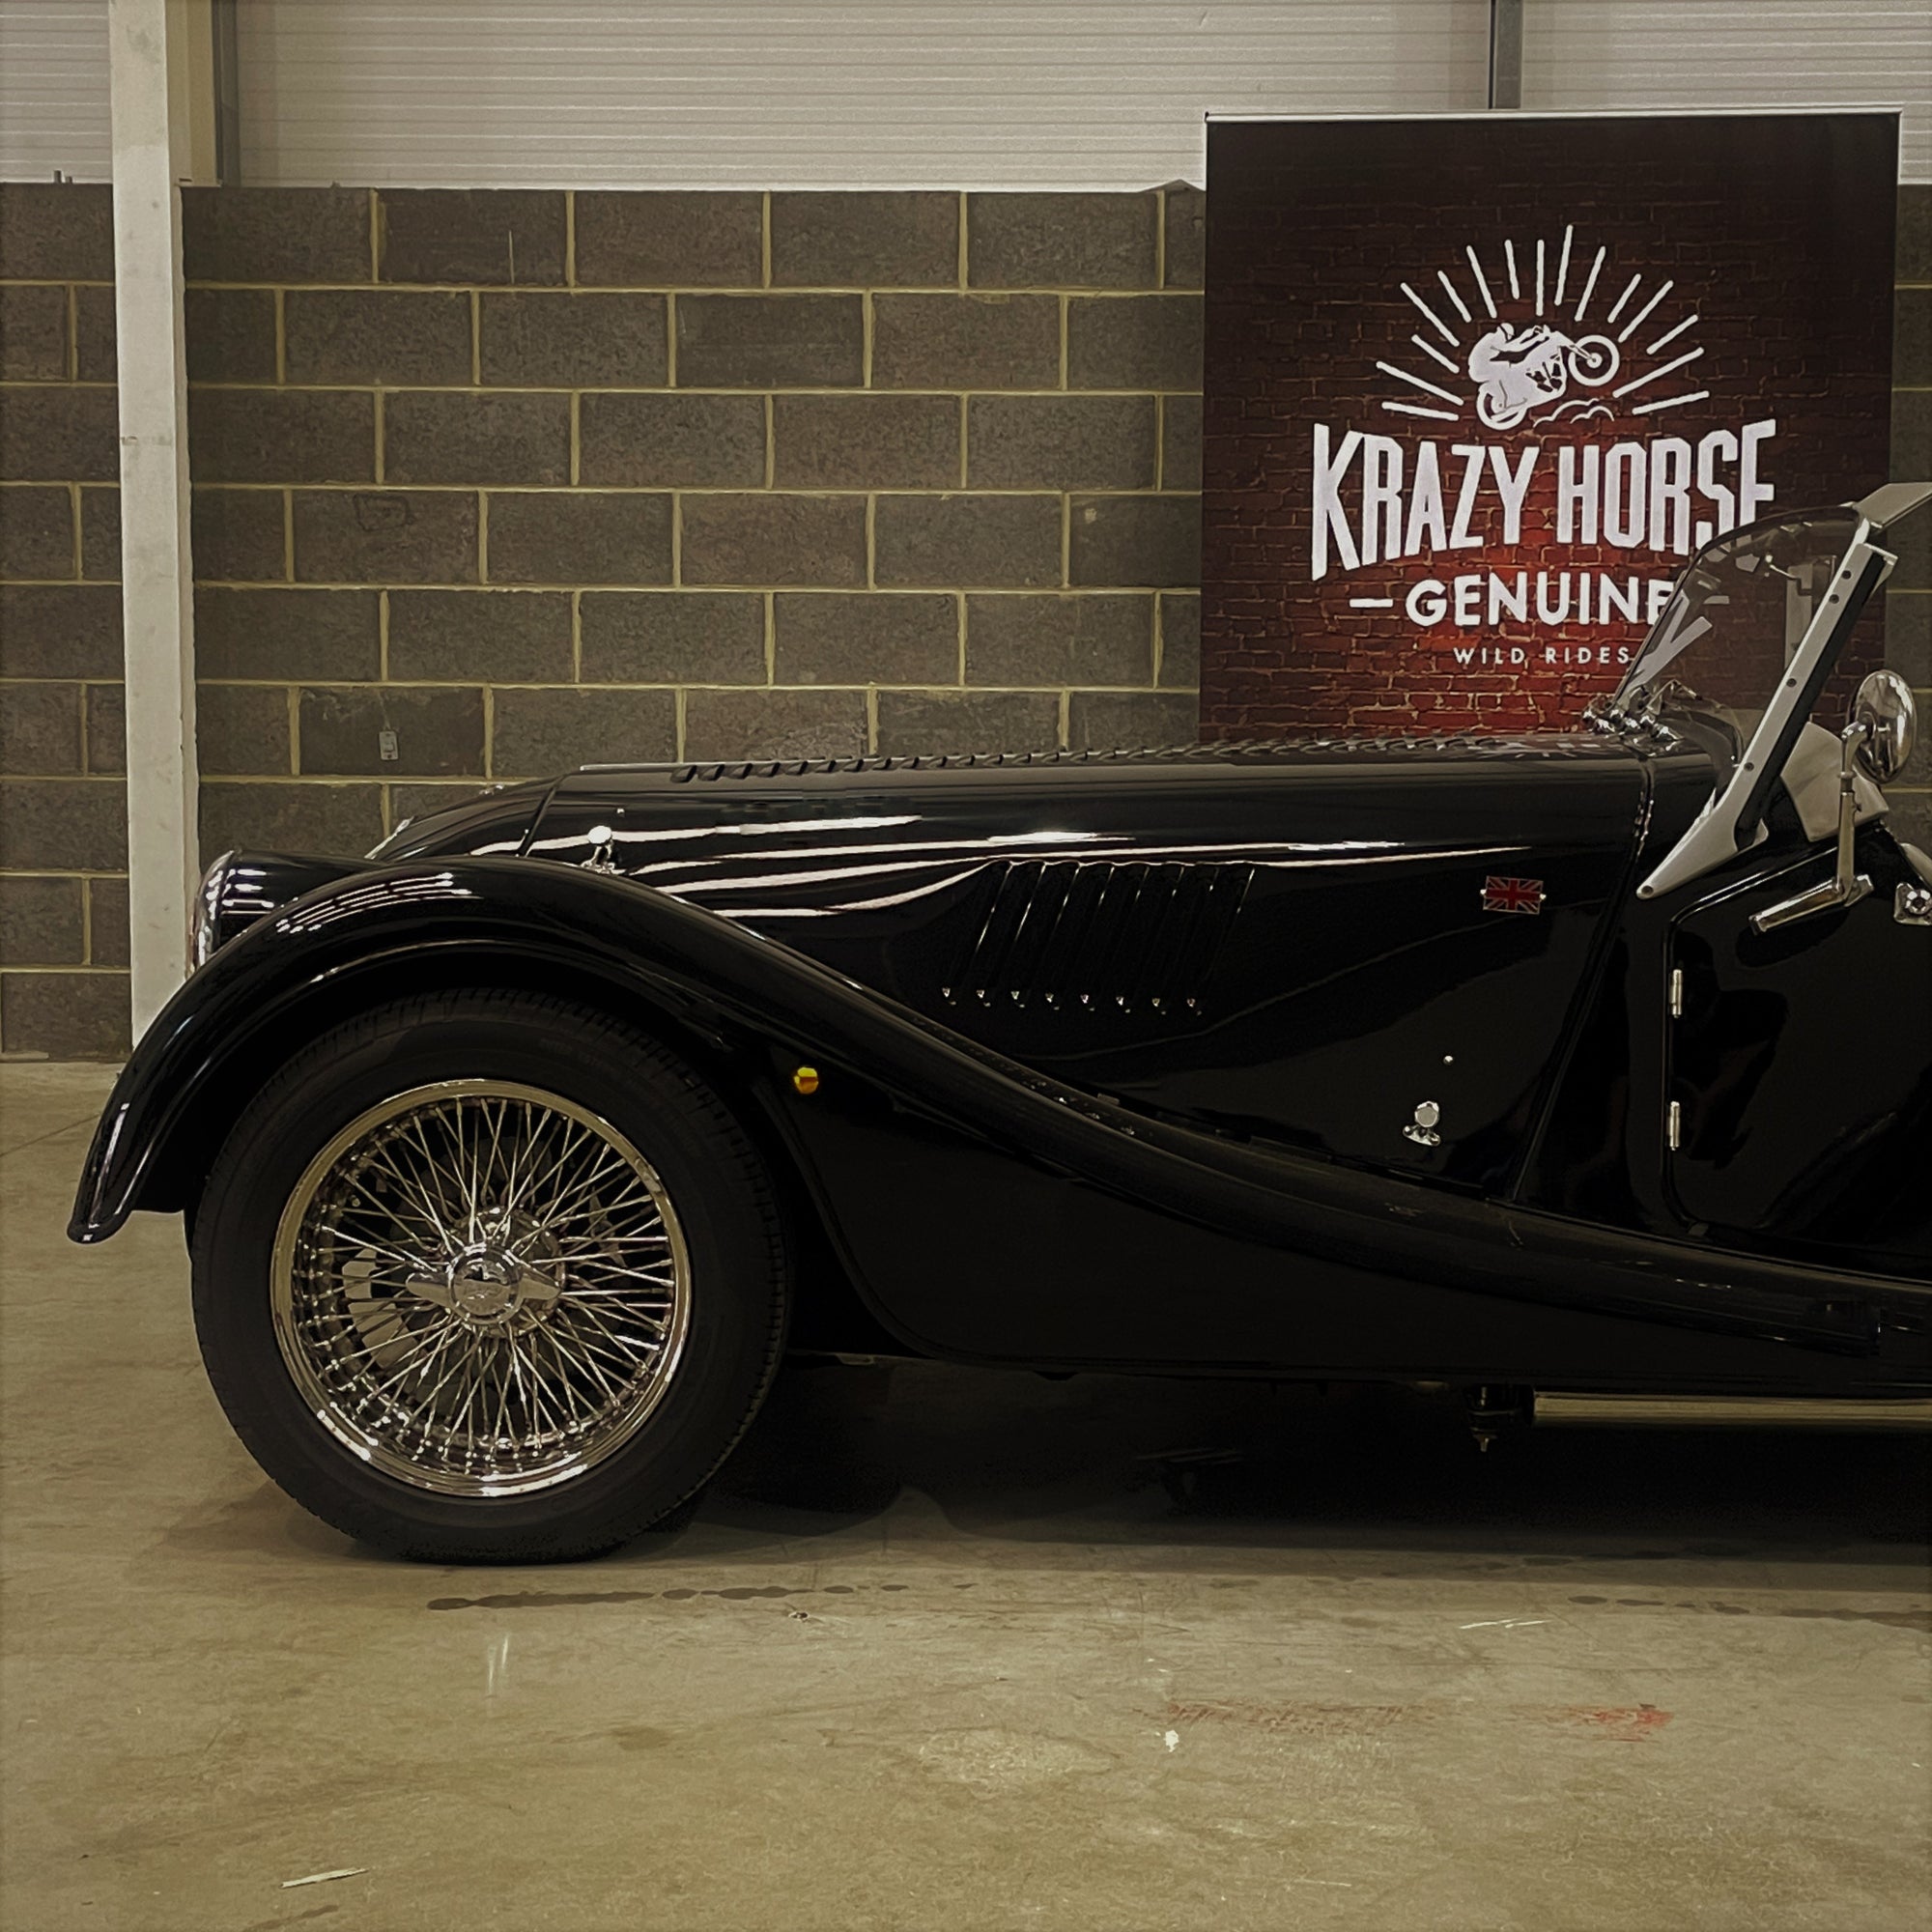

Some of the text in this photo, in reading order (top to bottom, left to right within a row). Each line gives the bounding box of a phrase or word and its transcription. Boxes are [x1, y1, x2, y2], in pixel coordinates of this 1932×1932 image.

[1312, 418, 1776, 581] KRAZY HORSE
[1406, 572, 1675, 626] GENUINE
[1453, 646, 1630, 665] WILD RIDES
